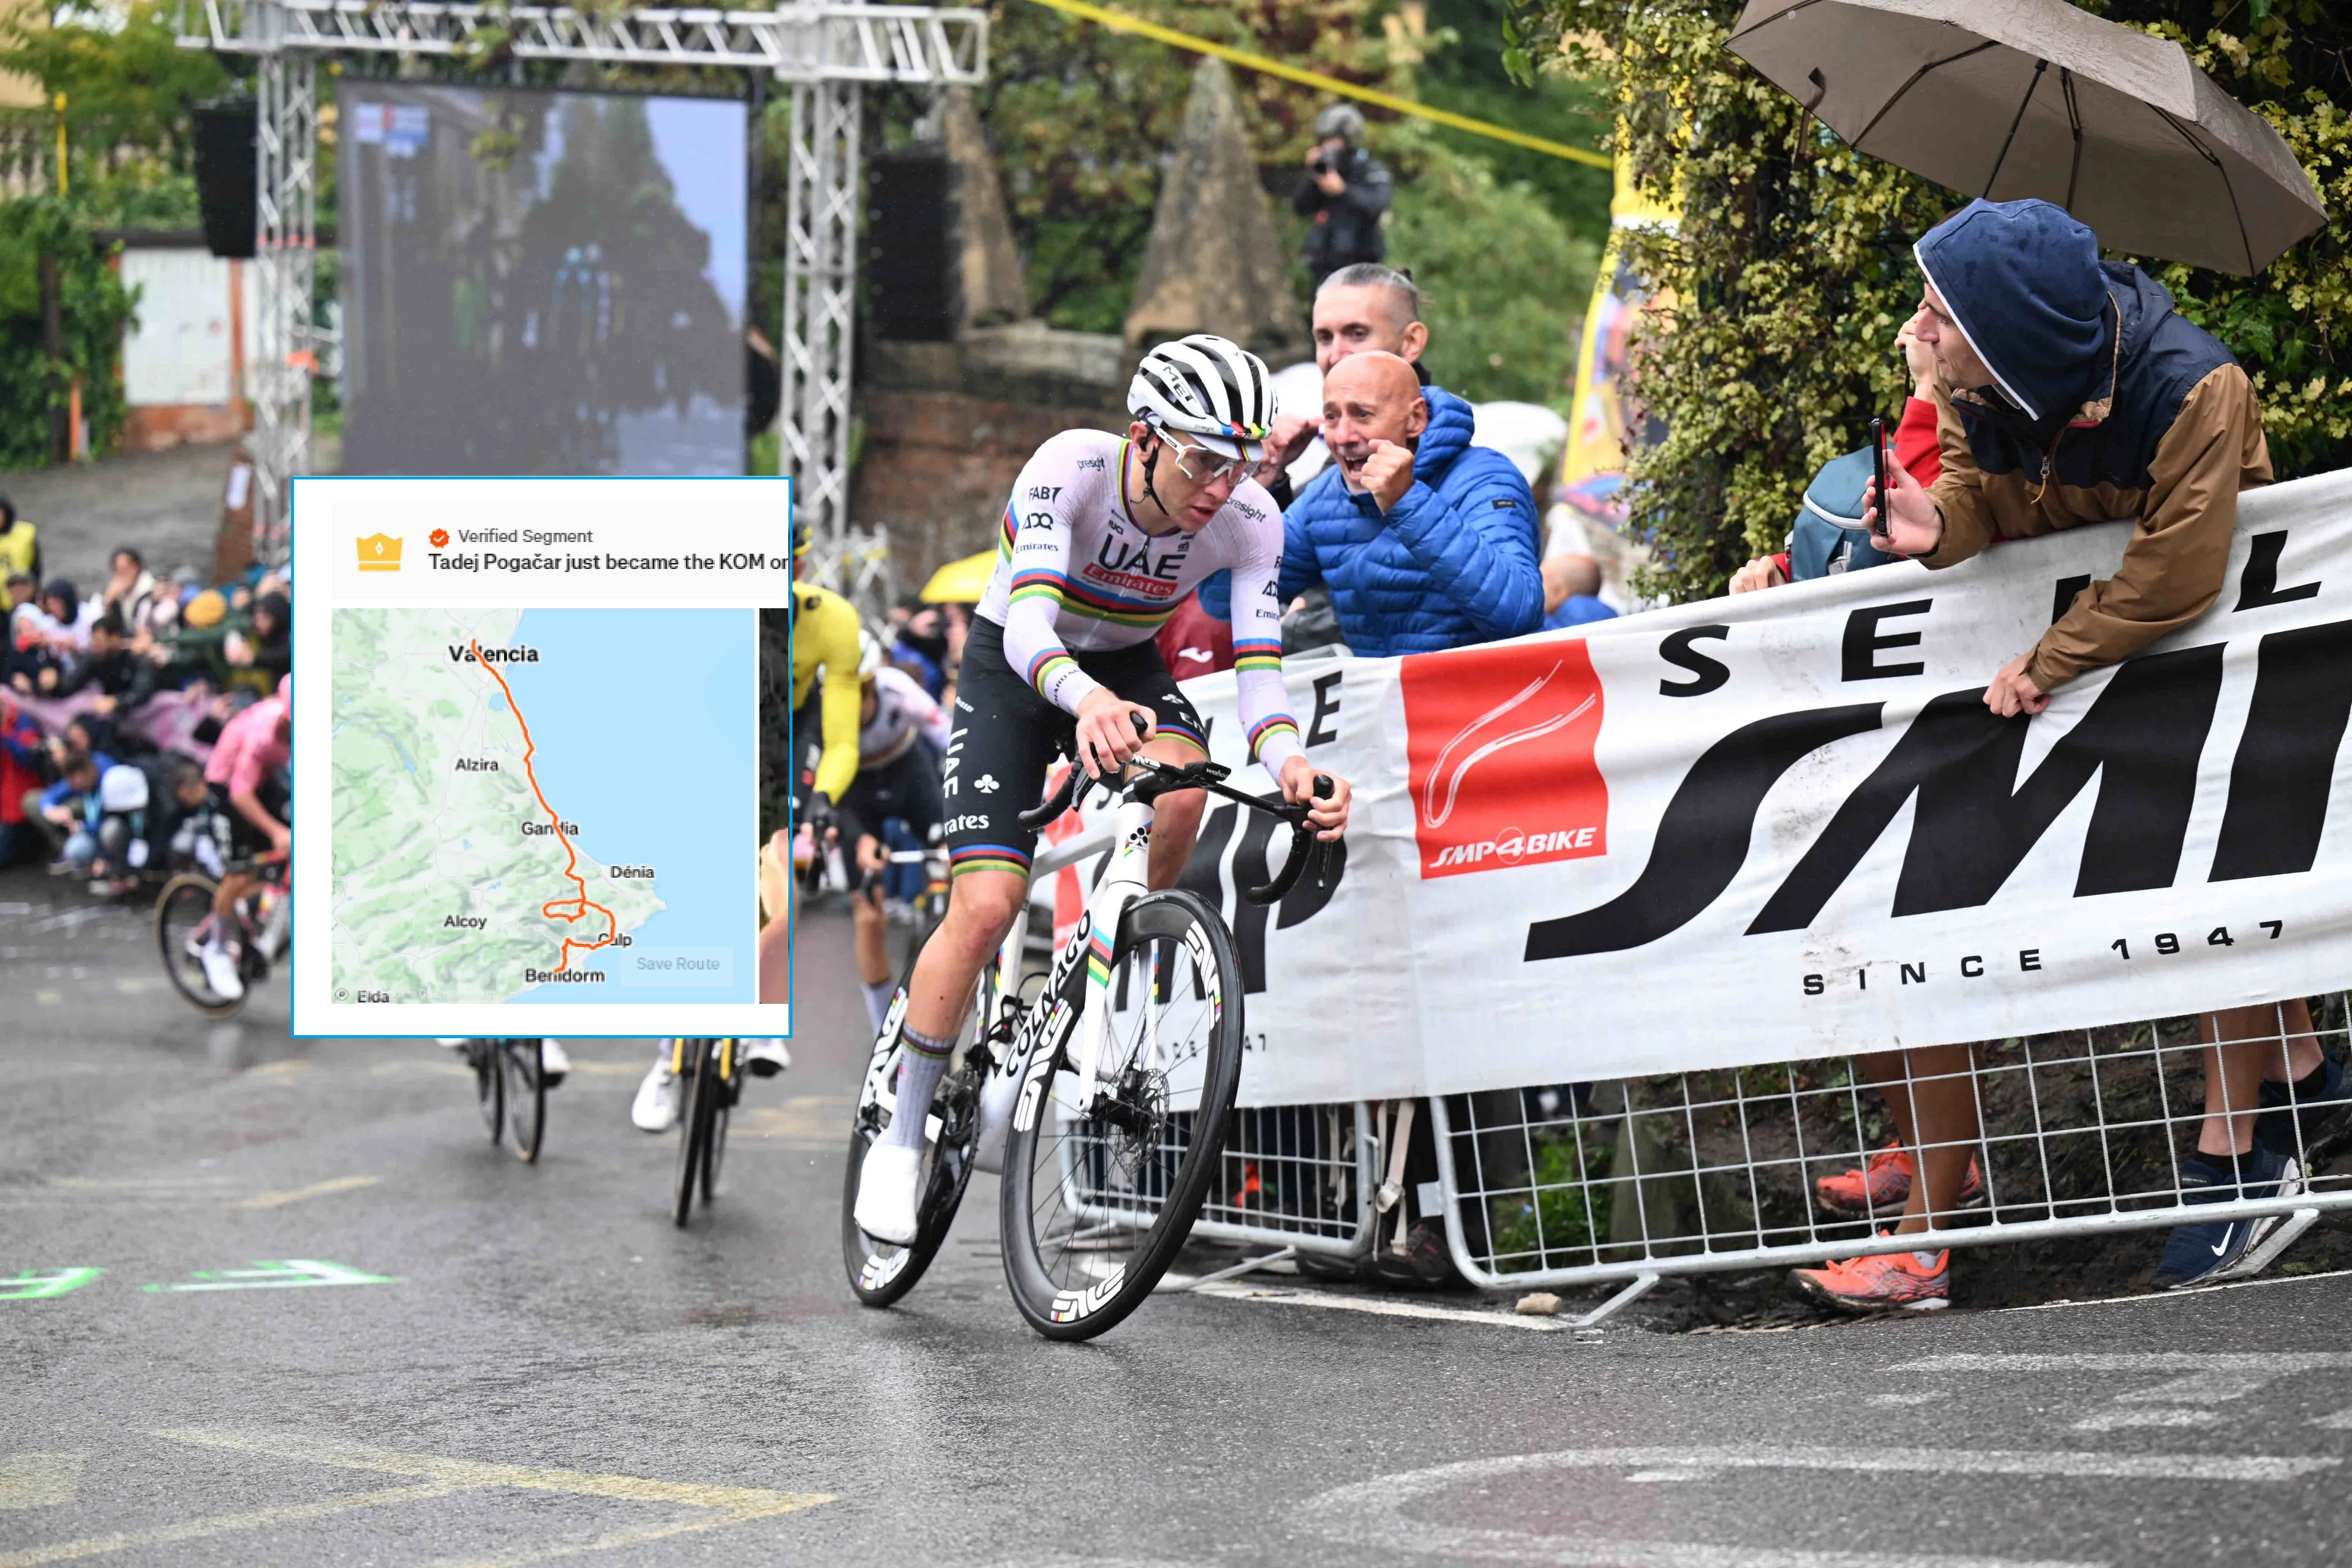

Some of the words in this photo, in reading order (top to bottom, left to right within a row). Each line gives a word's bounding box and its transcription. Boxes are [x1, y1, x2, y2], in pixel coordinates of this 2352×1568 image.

[1163, 366, 1197, 403] MET
[1077, 455, 1104, 472] presight
[1029, 486, 1050, 502] FAB
[1016, 542, 1059, 554] Emirates
[1098, 532, 1186, 581] UAE
[1088, 565, 1172, 595] Emirates
[944, 813, 990, 837] rates
[1429, 826, 1597, 869] SMP4BIKE
[1803, 948, 2041, 996] SINCE
[2111, 919, 2283, 960] 1947
[1006, 909, 1091, 1078] COLNAGO
